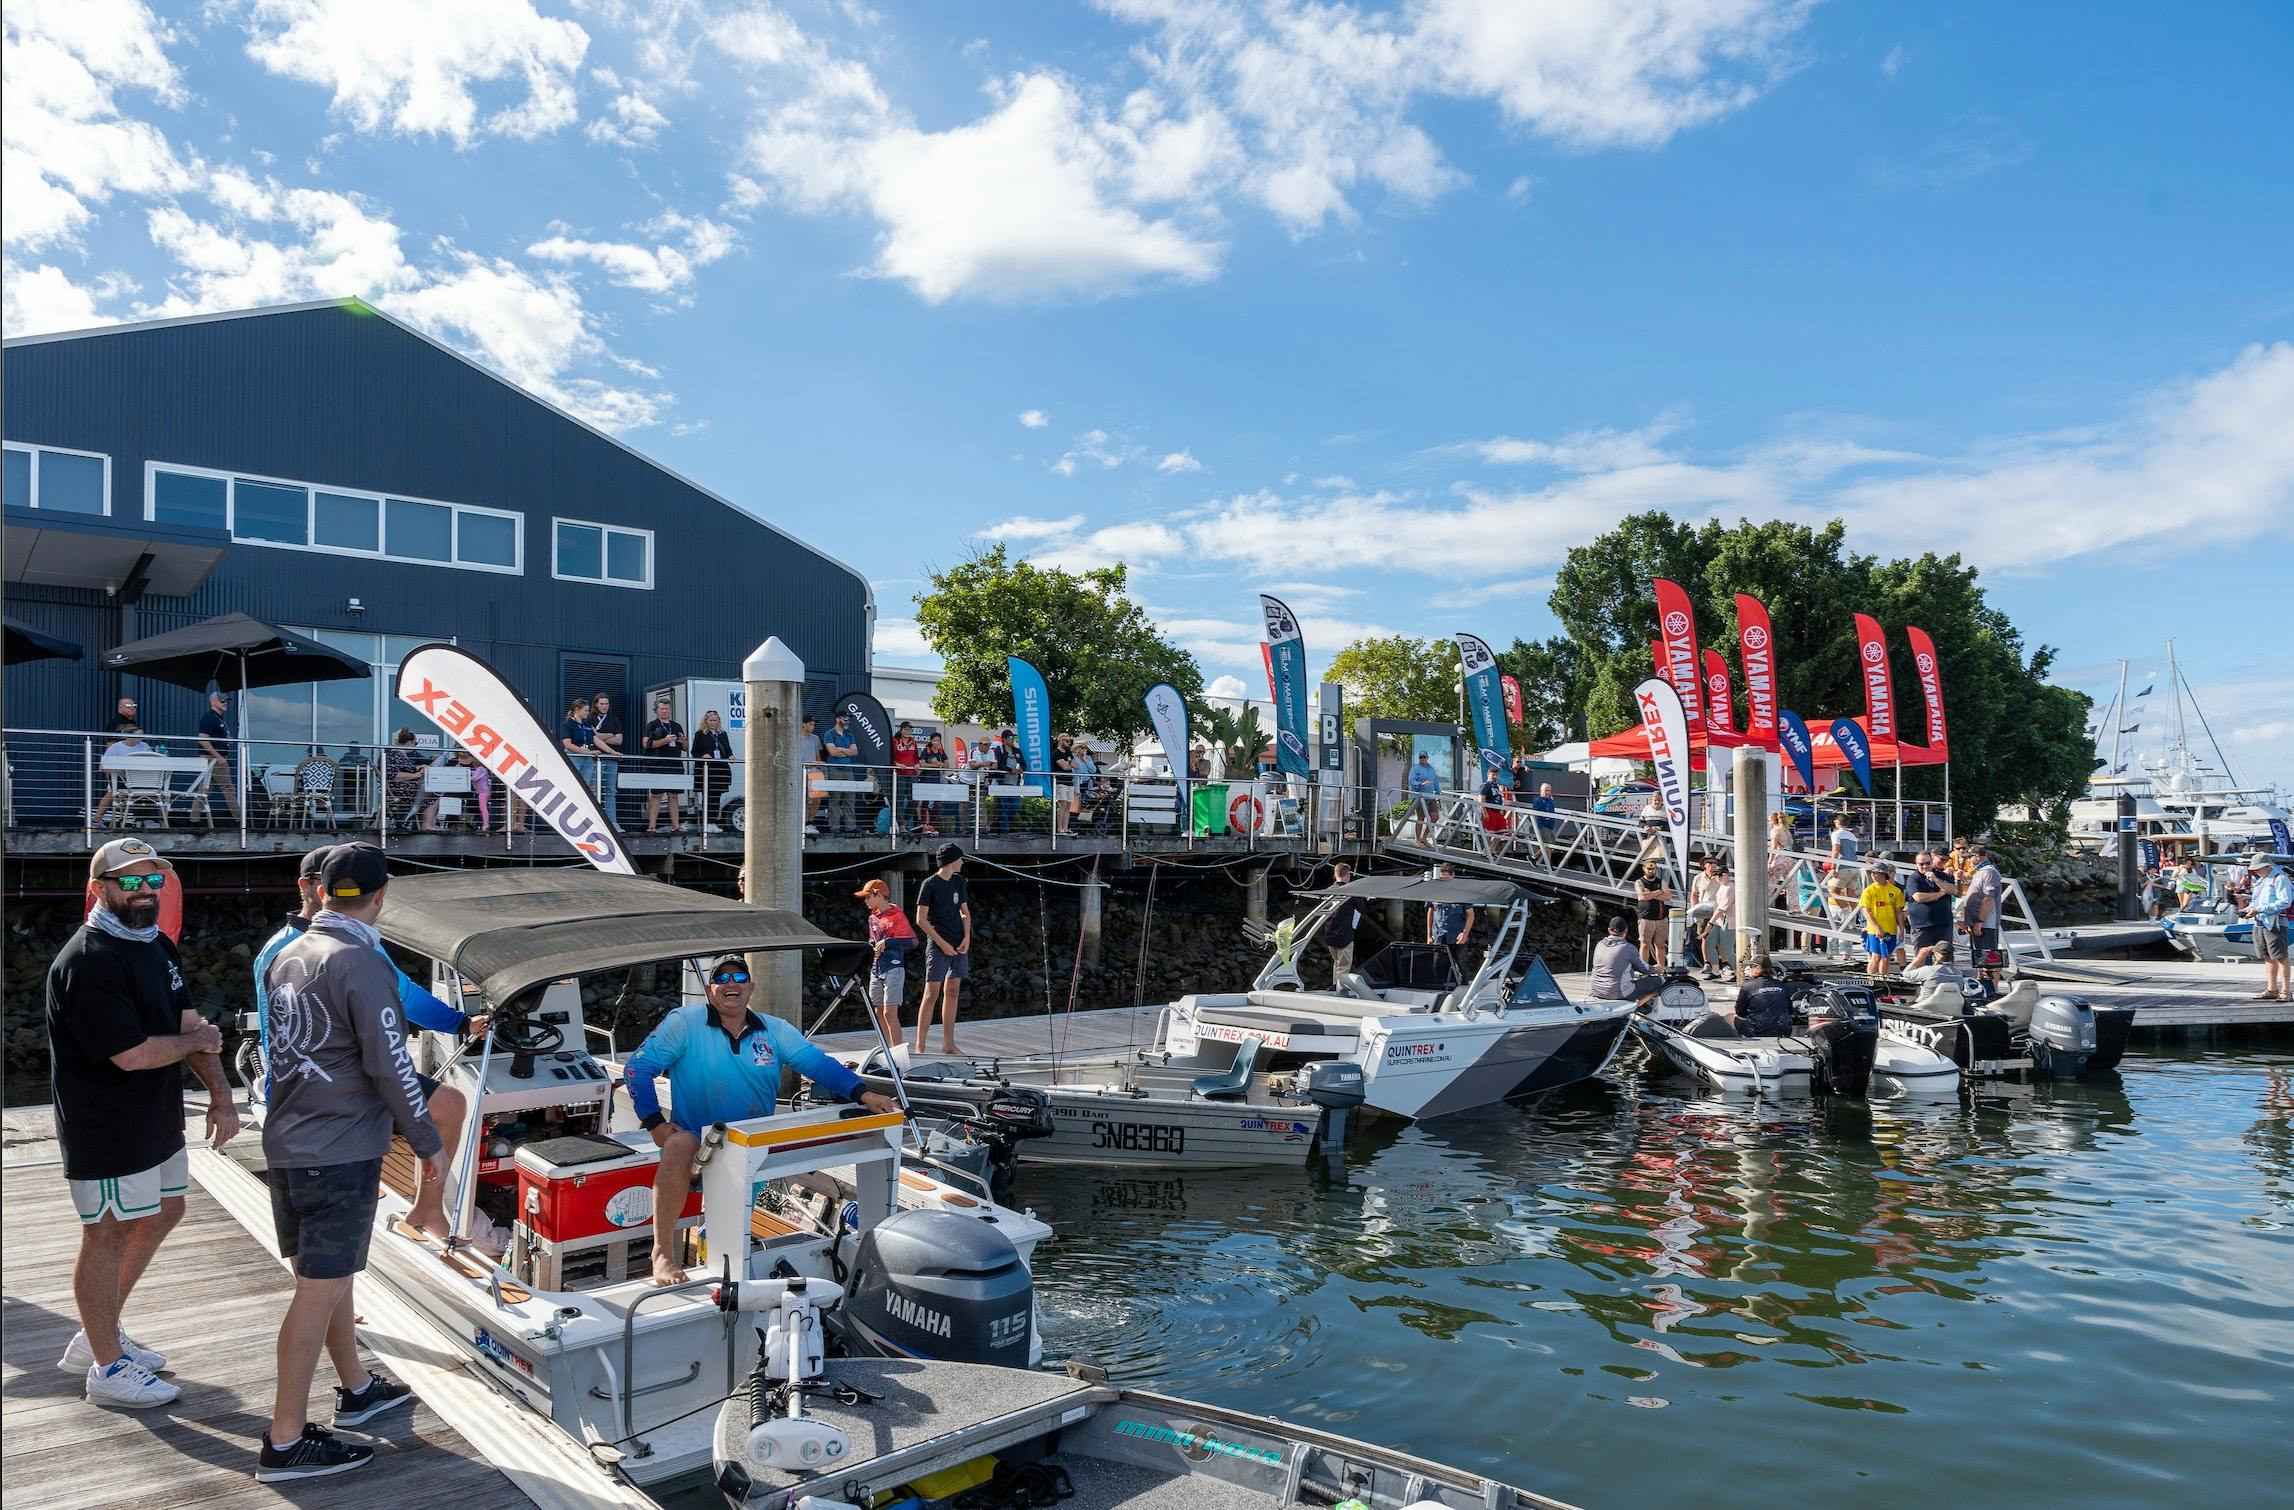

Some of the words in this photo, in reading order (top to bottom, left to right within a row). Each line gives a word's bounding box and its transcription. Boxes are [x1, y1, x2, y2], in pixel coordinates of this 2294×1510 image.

[1669, 636, 1700, 721] YAMAHA
[1746, 650, 1774, 729] YAMAHA
[1283, 682, 1294, 720] MASTER
[1867, 663, 1891, 736] YAMAHA
[1922, 673, 1944, 742] YAMAHA
[847, 703, 884, 748] GARMIN
[1024, 687, 1043, 772] SHIMANO
[1323, 715, 1337, 745] B
[1785, 727, 1807, 754] YMF
[1194, 1025, 1290, 1048] QUINTREXM.AU
[2050, 1023, 2073, 1033] YAMAHA
[380, 1006, 428, 1118] GARMIN
[1388, 1043, 1435, 1058] QUINTREX
[1340, 1073, 1361, 1081] YAMAHA
[992, 1103, 1035, 1115] MERCURY
[1240, 1119, 1292, 1132] QUINTREX
[1092, 1122, 1185, 1156] SN836Q
[886, 1288, 951, 1339] YAMAHA
[989, 1310, 1027, 1339] 115
[491, 1339, 534, 1378] QUINTREX
